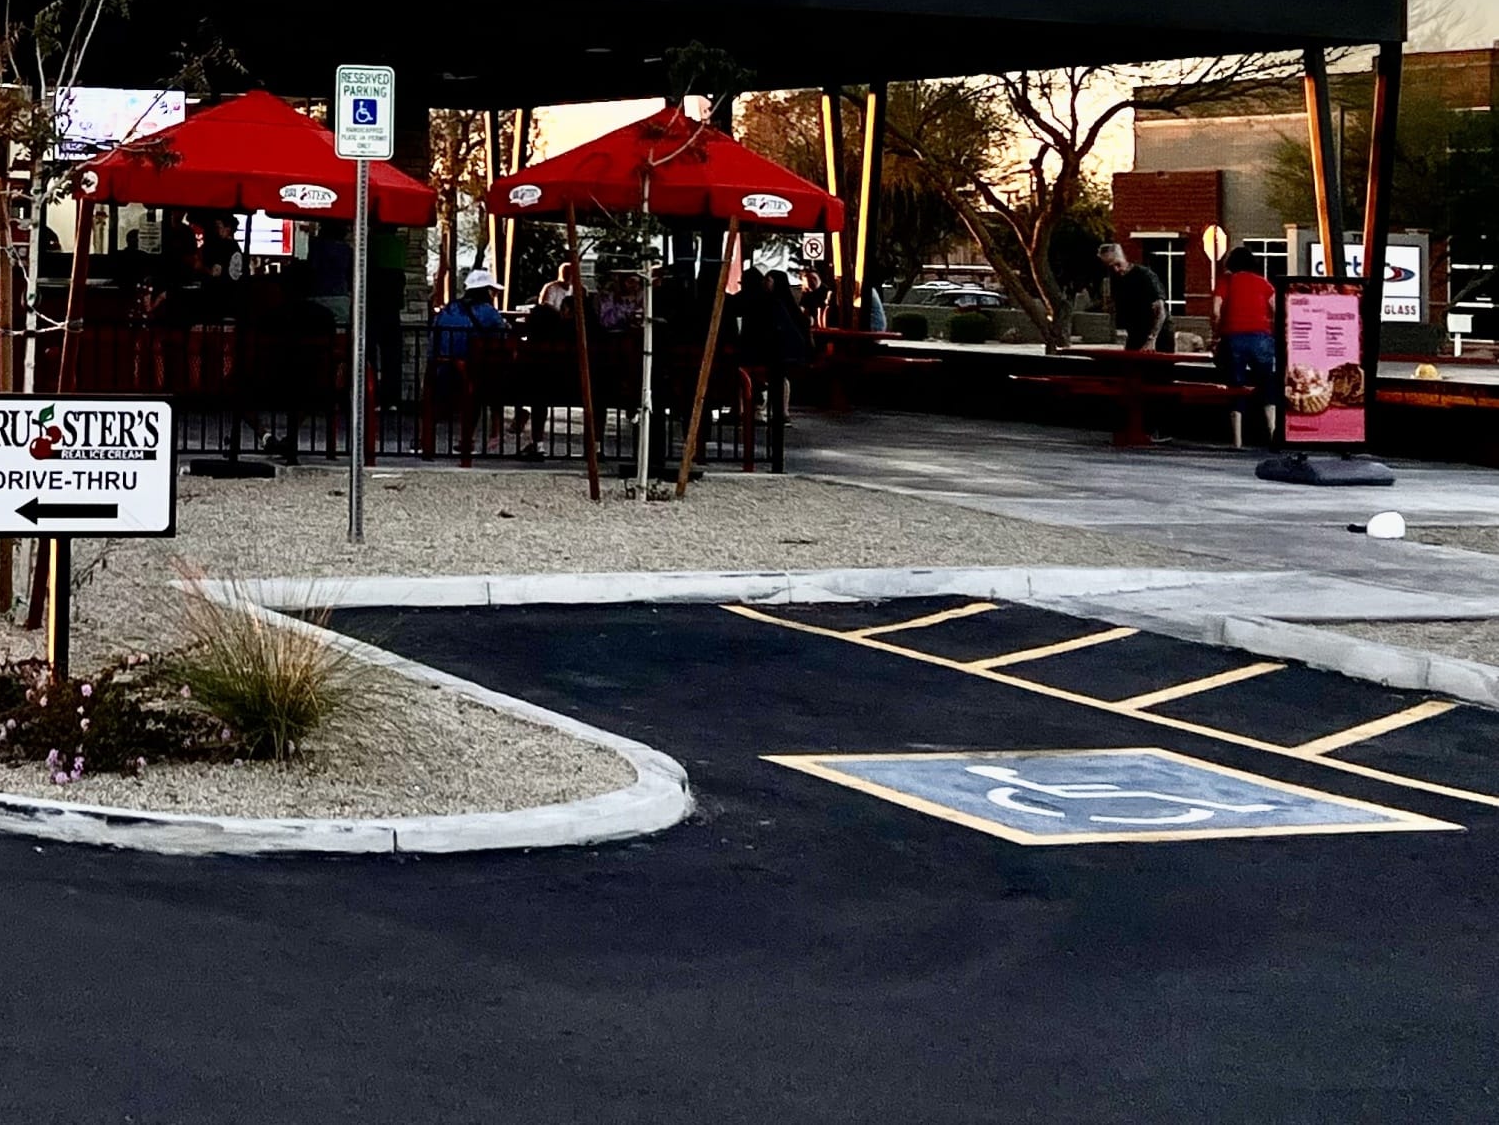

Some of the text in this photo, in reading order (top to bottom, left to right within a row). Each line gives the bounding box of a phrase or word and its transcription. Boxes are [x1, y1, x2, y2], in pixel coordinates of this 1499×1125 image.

[341, 72, 390, 85] RESERVED
[343, 85, 387, 98] PARKING
[1384, 304, 1417, 316] GLASS
[61, 450, 144, 460] REAL ICE CREAM
